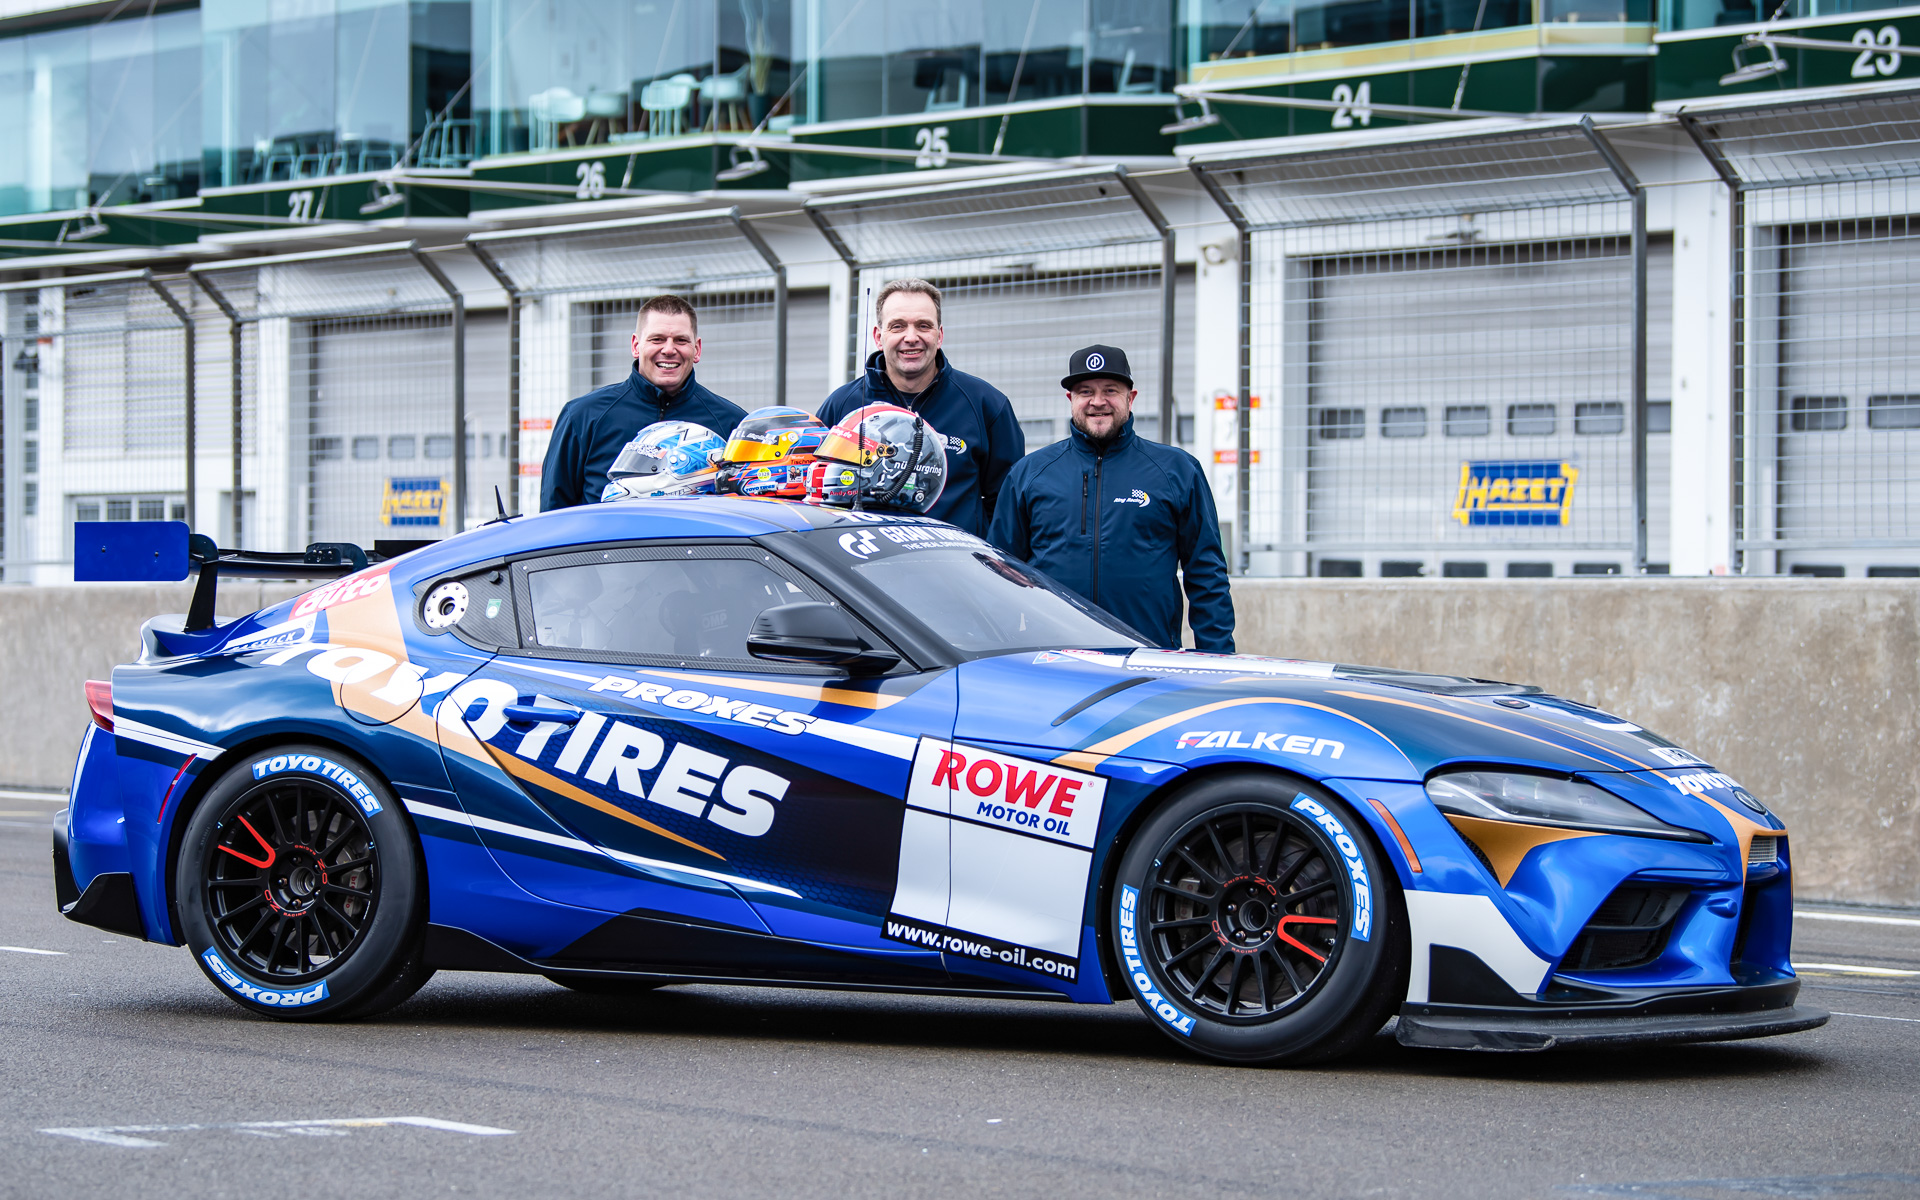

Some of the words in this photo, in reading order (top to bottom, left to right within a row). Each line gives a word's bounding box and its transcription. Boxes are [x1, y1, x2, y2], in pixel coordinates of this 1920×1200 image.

[1850, 25, 1901, 78] 23
[1331, 81, 1371, 129] 24
[915, 127, 949, 169] 25
[576, 161, 606, 200] 26
[288, 191, 314, 223] 27
[894, 461, 942, 477] nüurgring
[1465, 476, 1565, 510] HAZET
[878, 526, 936, 544] GRAN
[294, 573, 389, 617] auto
[702, 612, 728, 629] OMP
[587, 674, 819, 736] PROXES
[1174, 731, 1345, 760] FALKEN
[931, 748, 1084, 818] ROWE
[976, 802, 1040, 828] MOTOR
[1043, 818, 1071, 837] OIL
[1294, 797, 1370, 939] PROXES
[887, 921, 1076, 979] www.rowe-oil.com
[204, 954, 324, 1006] PROXES
